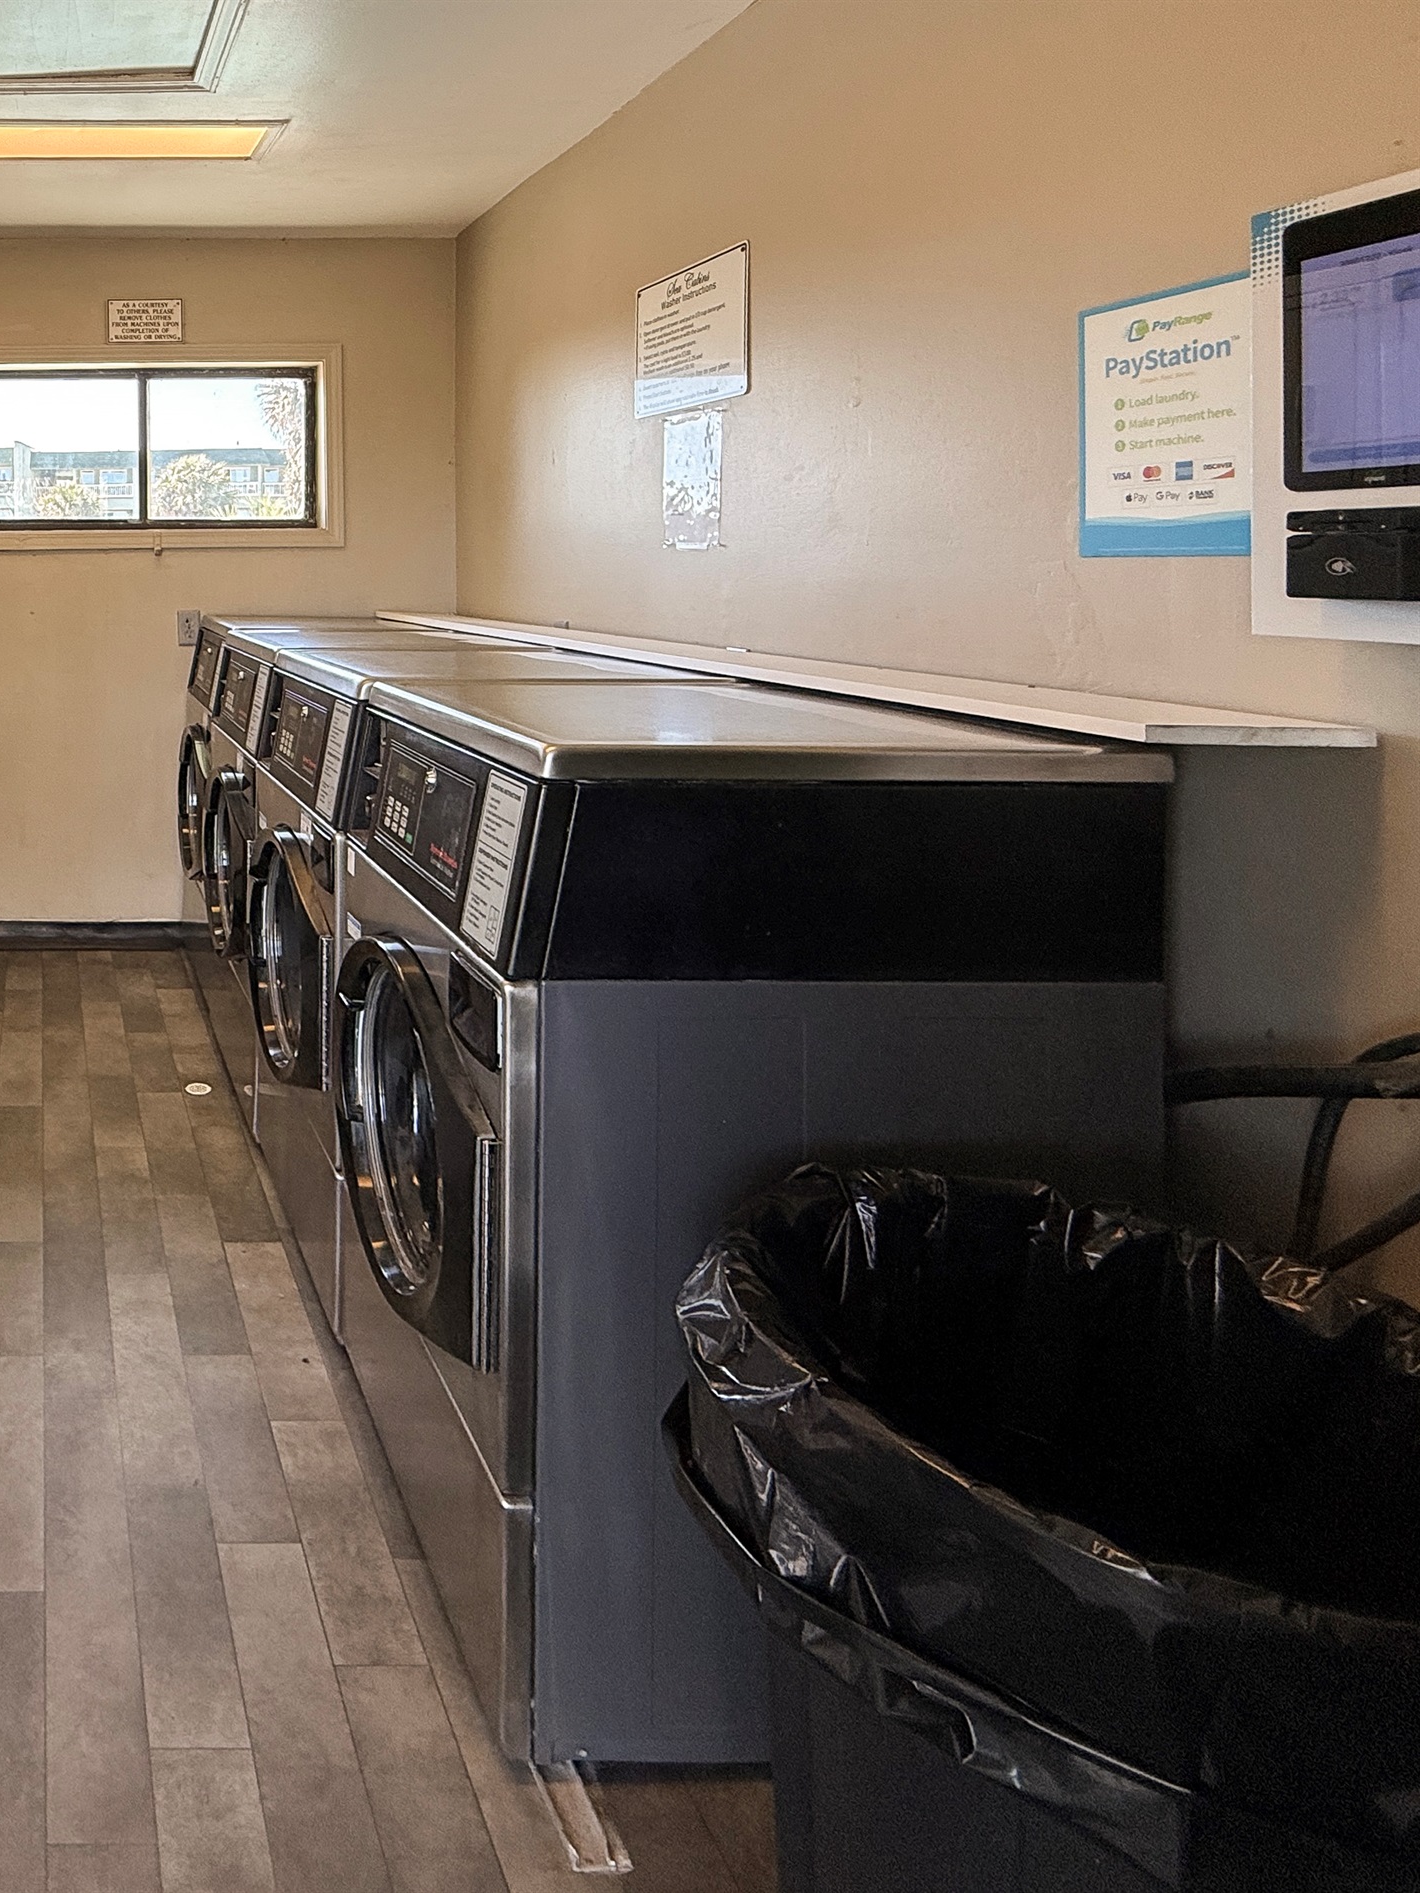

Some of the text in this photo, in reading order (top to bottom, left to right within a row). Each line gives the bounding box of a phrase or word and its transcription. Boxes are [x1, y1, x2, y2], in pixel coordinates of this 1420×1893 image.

[684, 271, 710, 291] Cabins
[661, 282, 716, 310] Washer Instructions
[1151, 312, 1212, 332] PayRange
[1129, 390, 1200, 408] Load laundry.
[1129, 417, 1155, 429] Make
[1156, 410, 1205, 428] payment
[1207, 408, 1237, 419] here.
[1129, 440, 1153, 451] Start
[1155, 433, 1205, 446] machine.
[1112, 462, 1233, 480] VISA DISCOVER
[1133, 493, 1148, 504] Pay
[1165, 490, 1181, 501] Pay
